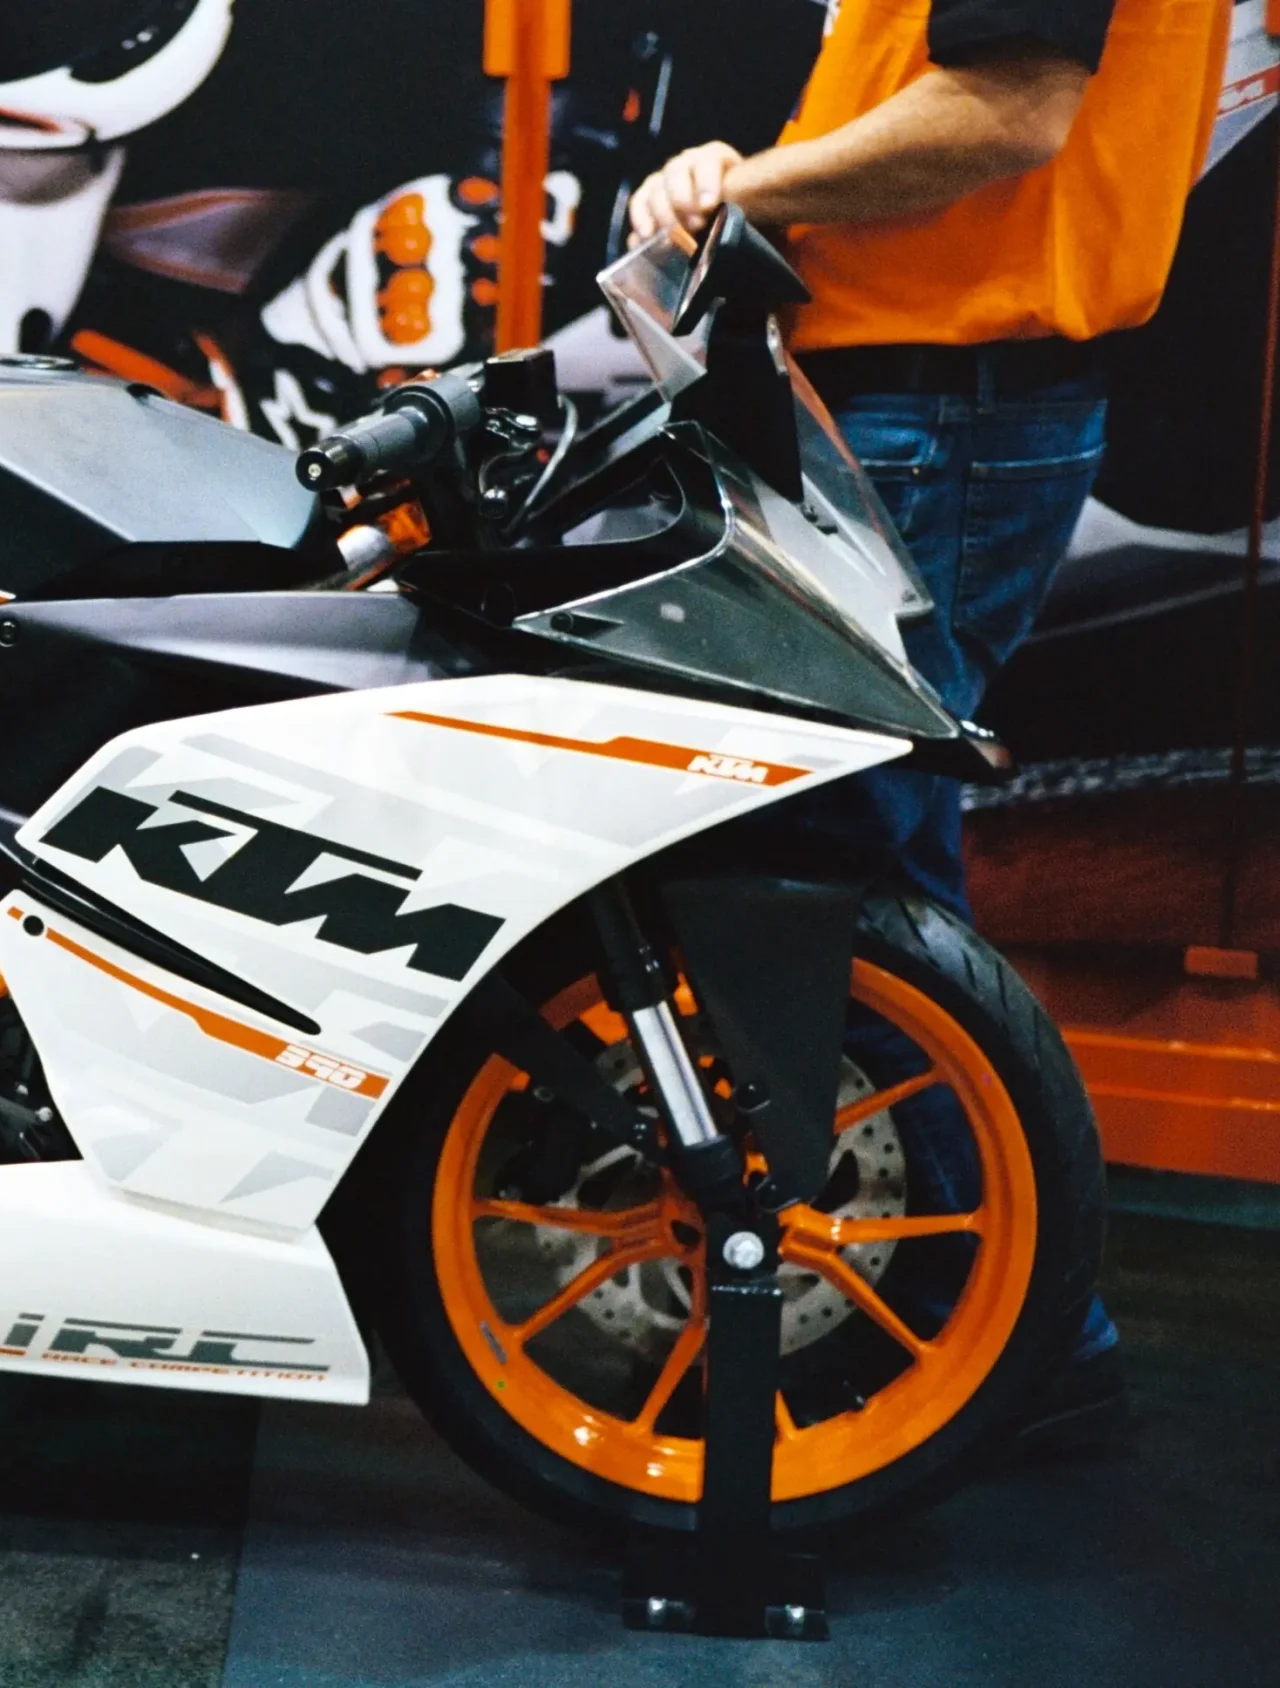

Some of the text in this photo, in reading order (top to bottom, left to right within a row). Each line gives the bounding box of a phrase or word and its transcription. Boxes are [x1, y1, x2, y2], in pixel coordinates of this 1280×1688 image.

[687, 753, 769, 784] KTM
[38, 785, 507, 983] KTM
[275, 1044, 367, 1089] 390
